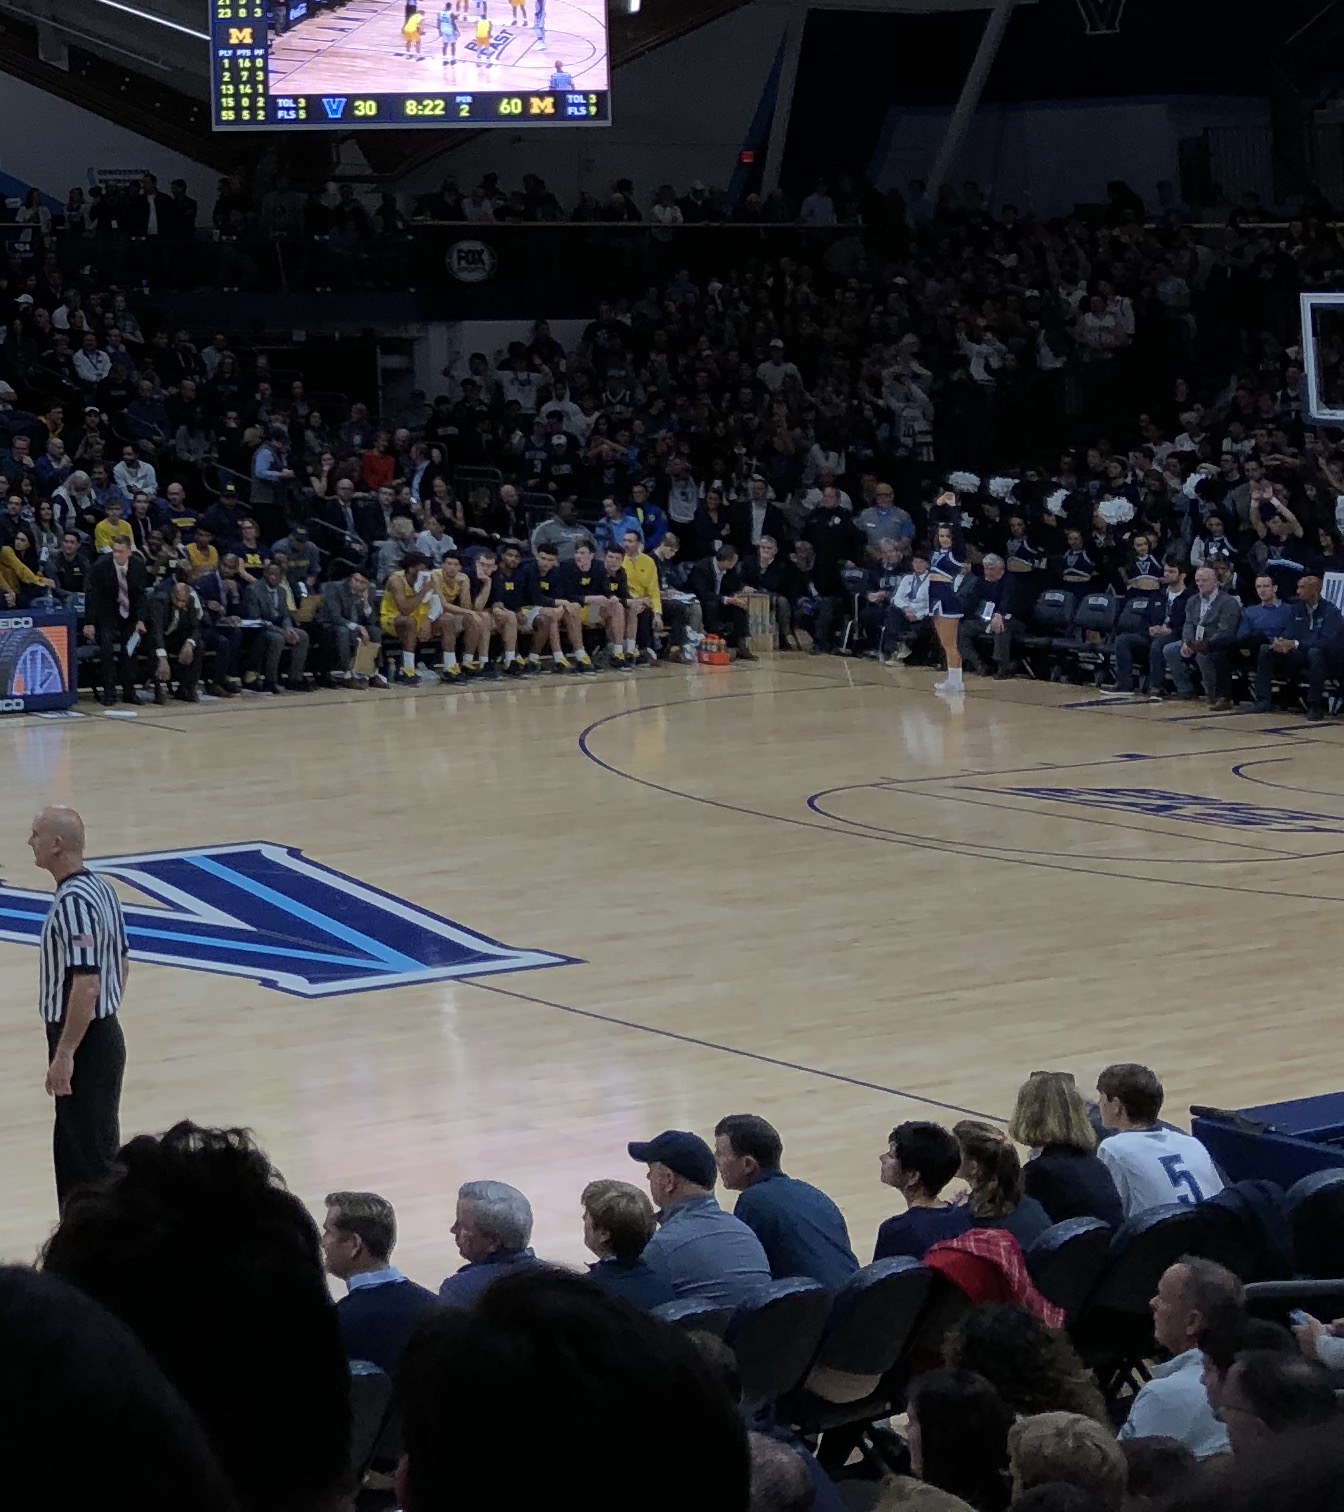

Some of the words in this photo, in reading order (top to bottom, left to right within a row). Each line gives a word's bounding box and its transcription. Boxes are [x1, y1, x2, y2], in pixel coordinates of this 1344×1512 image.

[253, 7, 263, 18] 3
[222, 58, 230, 69] 1
[237, 58, 252, 68] 16
[255, 57, 265, 68] 0
[222, 71, 232, 82] 2
[240, 71, 250, 81] 7
[256, 83, 264, 94] 1
[256, 96, 266, 107] 2
[276, 97, 298, 108] TOL
[298, 97, 307, 108] 3
[566, 93, 588, 104] TOL
[589, 93, 598, 104] 3
[353, 98, 378, 117] 30
[404, 97, 446, 116] 8:22
[498, 96, 523, 115] 60
[458, 104, 471, 118] 2
[566, 105, 588, 117] FLS
[589, 105, 599, 116] 9
[220, 110, 236, 121] 55
[241, 110, 251, 121] 5
[256, 109, 267, 120] 2
[276, 109, 298, 120] FLS
[298, 108, 307, 120] 5
[456, 248, 486, 266] FOX
[1158, 1152, 1205, 1206] 5
